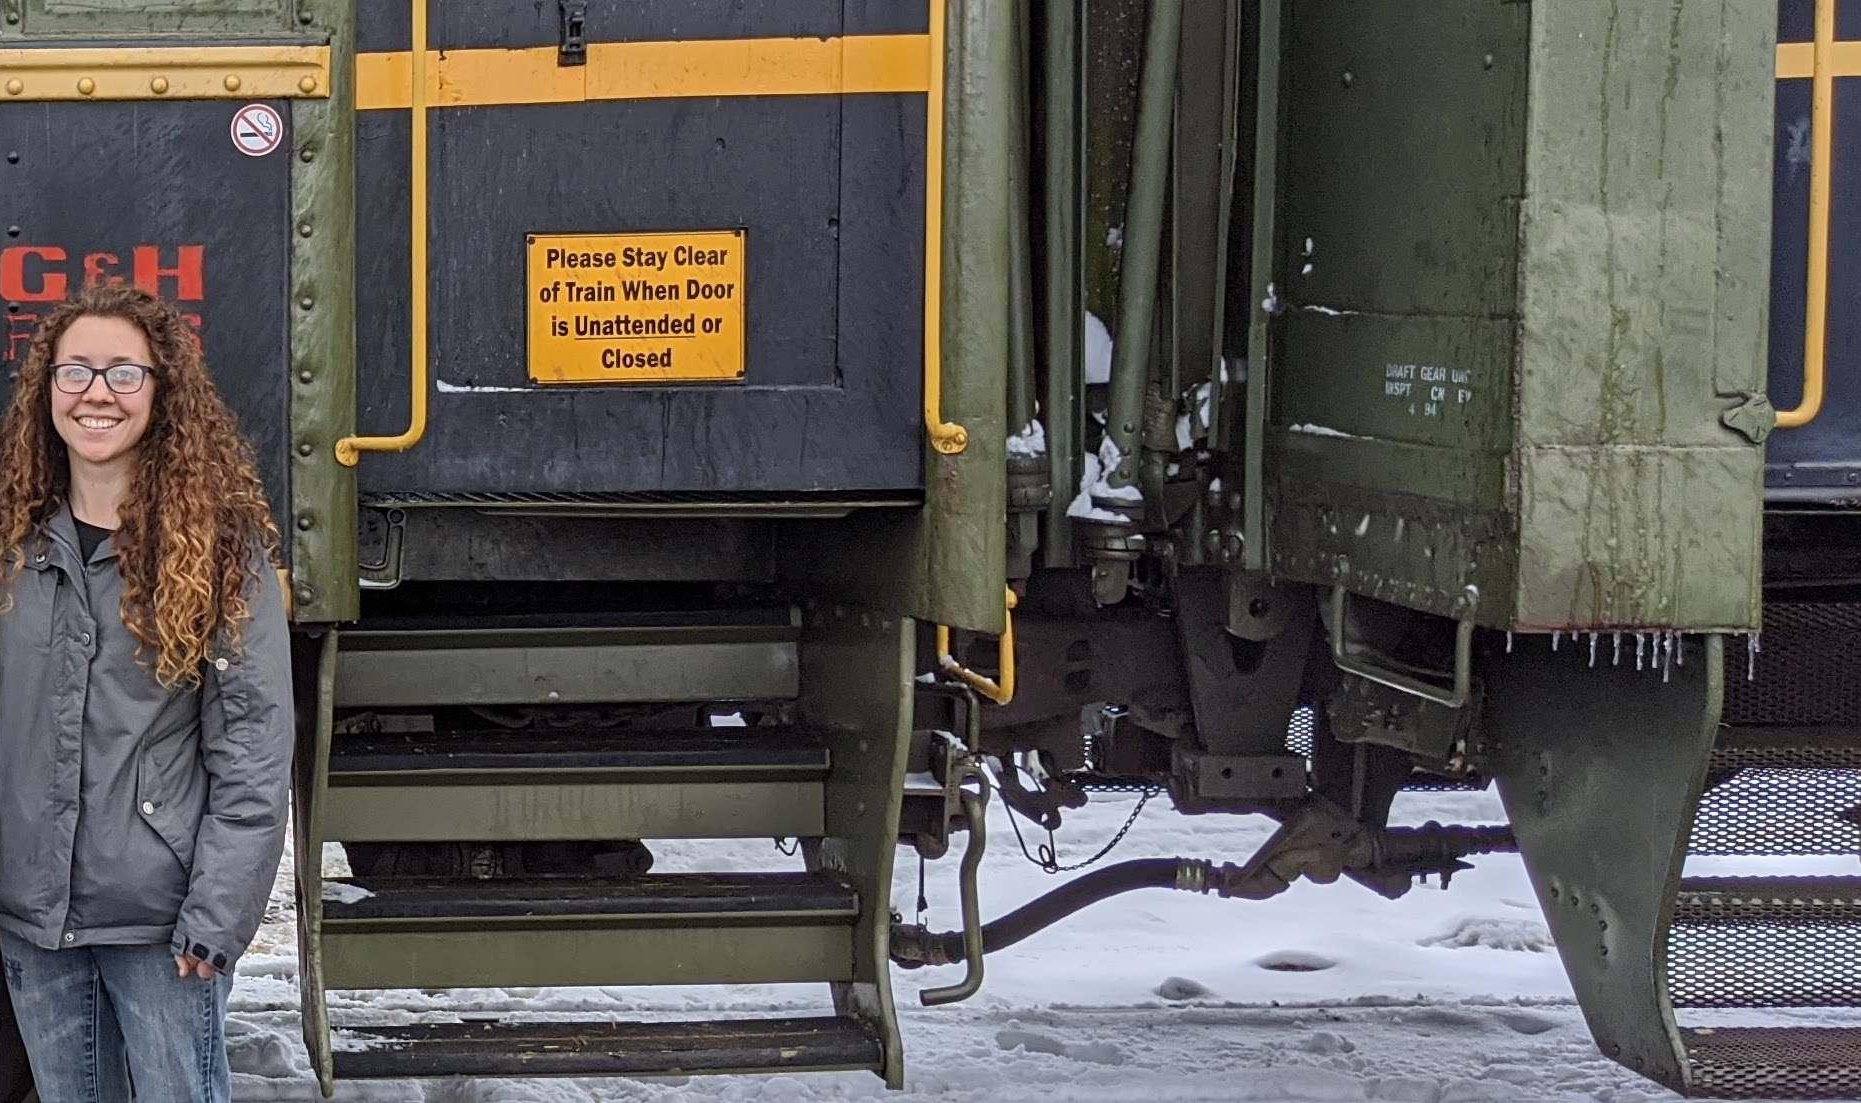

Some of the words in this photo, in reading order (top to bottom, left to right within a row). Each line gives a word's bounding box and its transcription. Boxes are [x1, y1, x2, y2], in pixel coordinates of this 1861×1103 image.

[546, 248, 616, 269] Please
[622, 247, 668, 271] Stay
[673, 246, 728, 266] Clear
[539, 281, 560, 303] of
[565, 281, 615, 302] Train
[622, 280, 680, 301] When
[686, 279, 735, 300] Door
[551, 316, 569, 336] is
[574, 313, 695, 336] Unattended
[701, 316, 723, 333] or
[601, 348, 672, 368] Closed
[1386, 364, 1416, 379] DRAFT
[1420, 366, 1446, 382] GEAR
